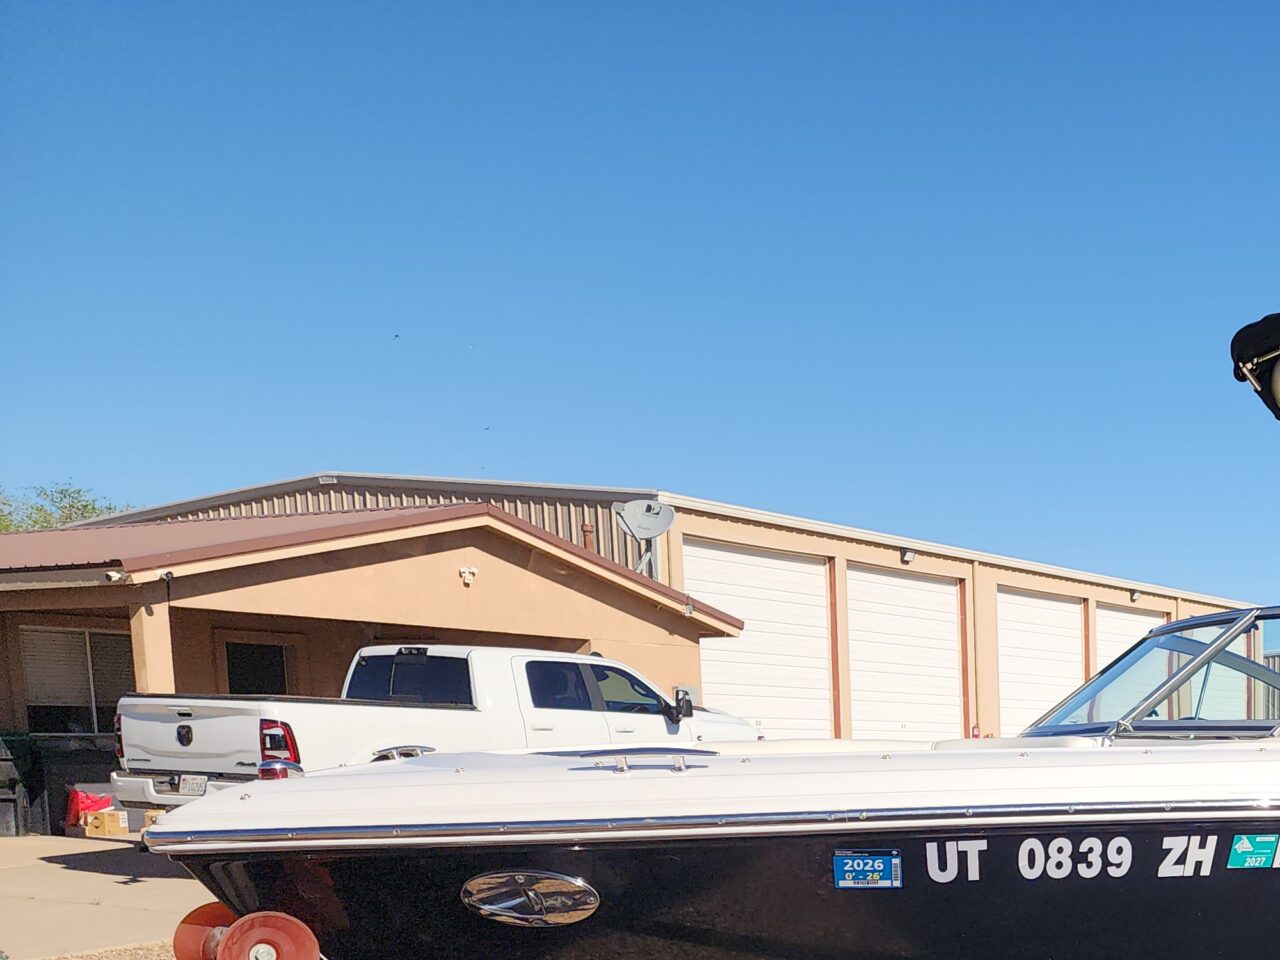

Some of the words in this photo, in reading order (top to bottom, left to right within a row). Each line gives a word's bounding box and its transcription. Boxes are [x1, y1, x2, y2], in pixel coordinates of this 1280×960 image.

[843, 859, 884, 871] 2026
[925, 839, 988, 884] UT
[1017, 836, 1133, 880] 0839
[1157, 835, 1218, 878] ZH
[1244, 857, 1266, 867] 2027
